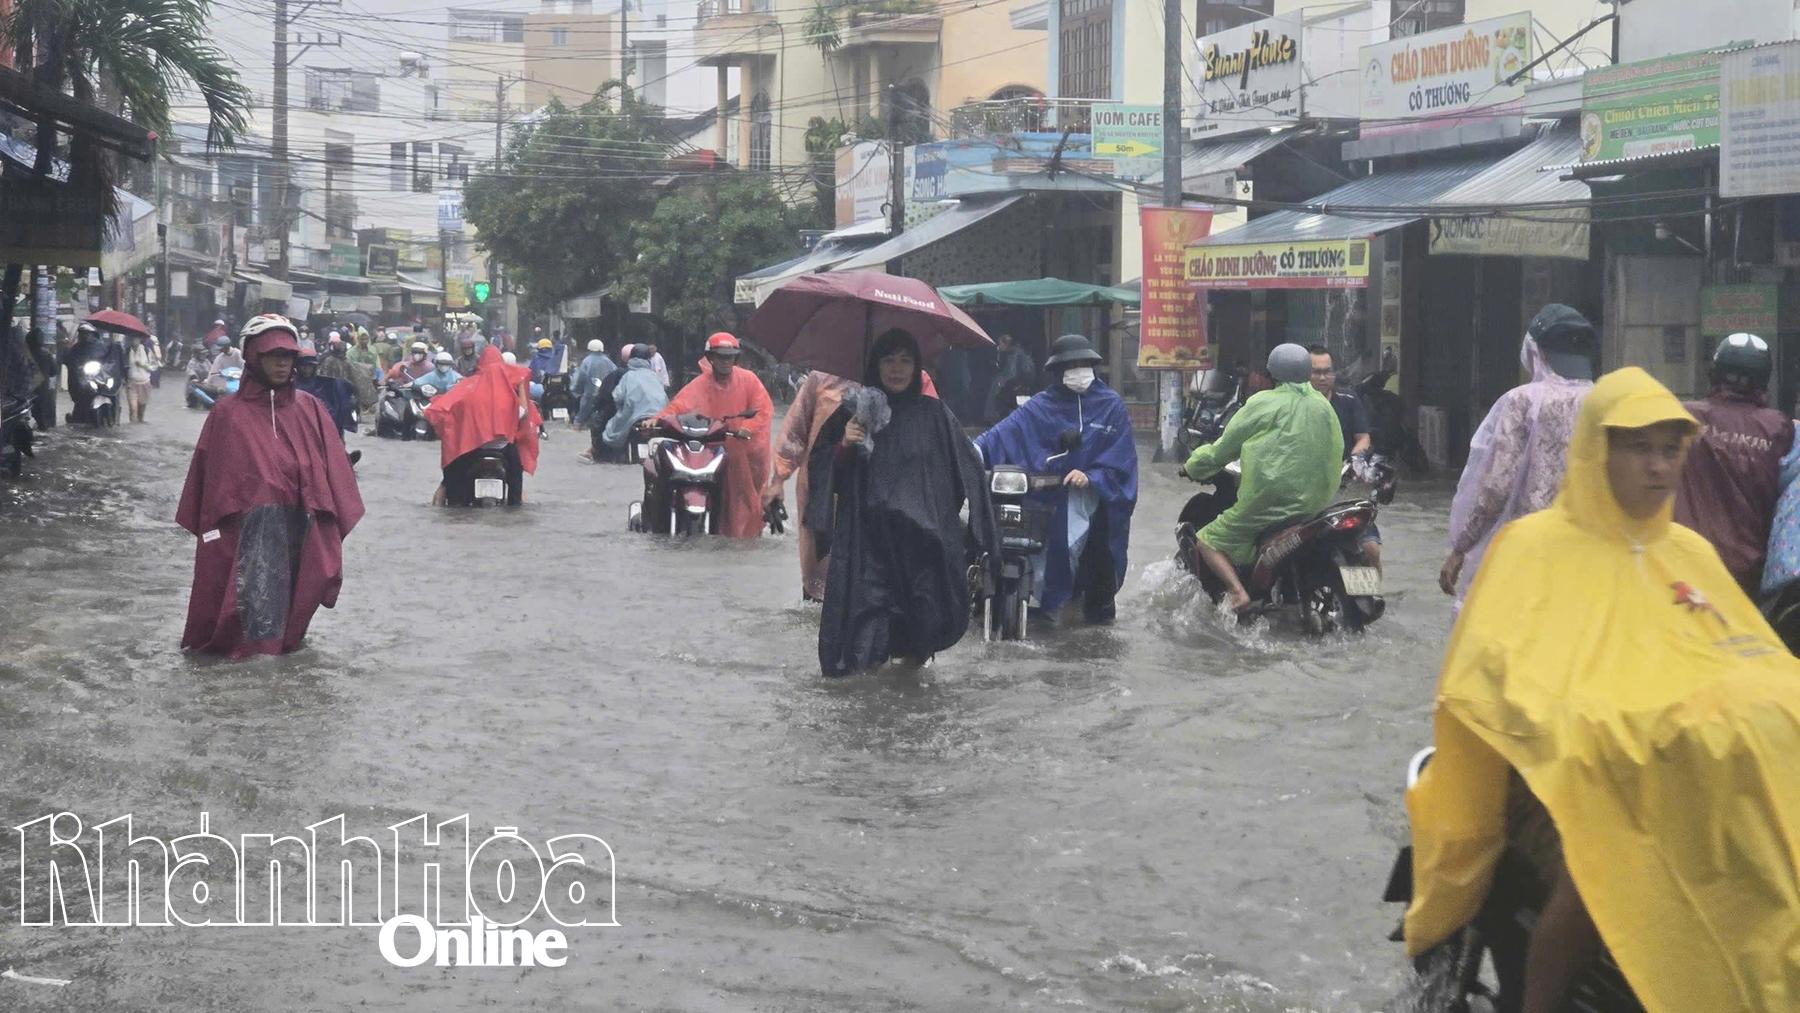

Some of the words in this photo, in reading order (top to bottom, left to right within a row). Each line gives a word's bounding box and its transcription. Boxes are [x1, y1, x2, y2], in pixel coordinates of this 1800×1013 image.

[1251, 29, 1296, 70] House
[1391, 43, 1418, 84] CHÁO
[1421, 43, 1448, 78] DINH
[1450, 29, 1490, 72] DƯỠNG
[1409, 85, 1423, 111] CÔ
[1425, 81, 1470, 109] THƯƠNG
[1129, 112, 1161, 126] CAFE
[1189, 252, 1213, 277] CHÁO
[1216, 256, 1241, 277] DINH
[1242, 250, 1277, 276] DƯỠNG
[1280, 247, 1294, 269] CÔ
[874, 288, 935, 309] NutiFood
